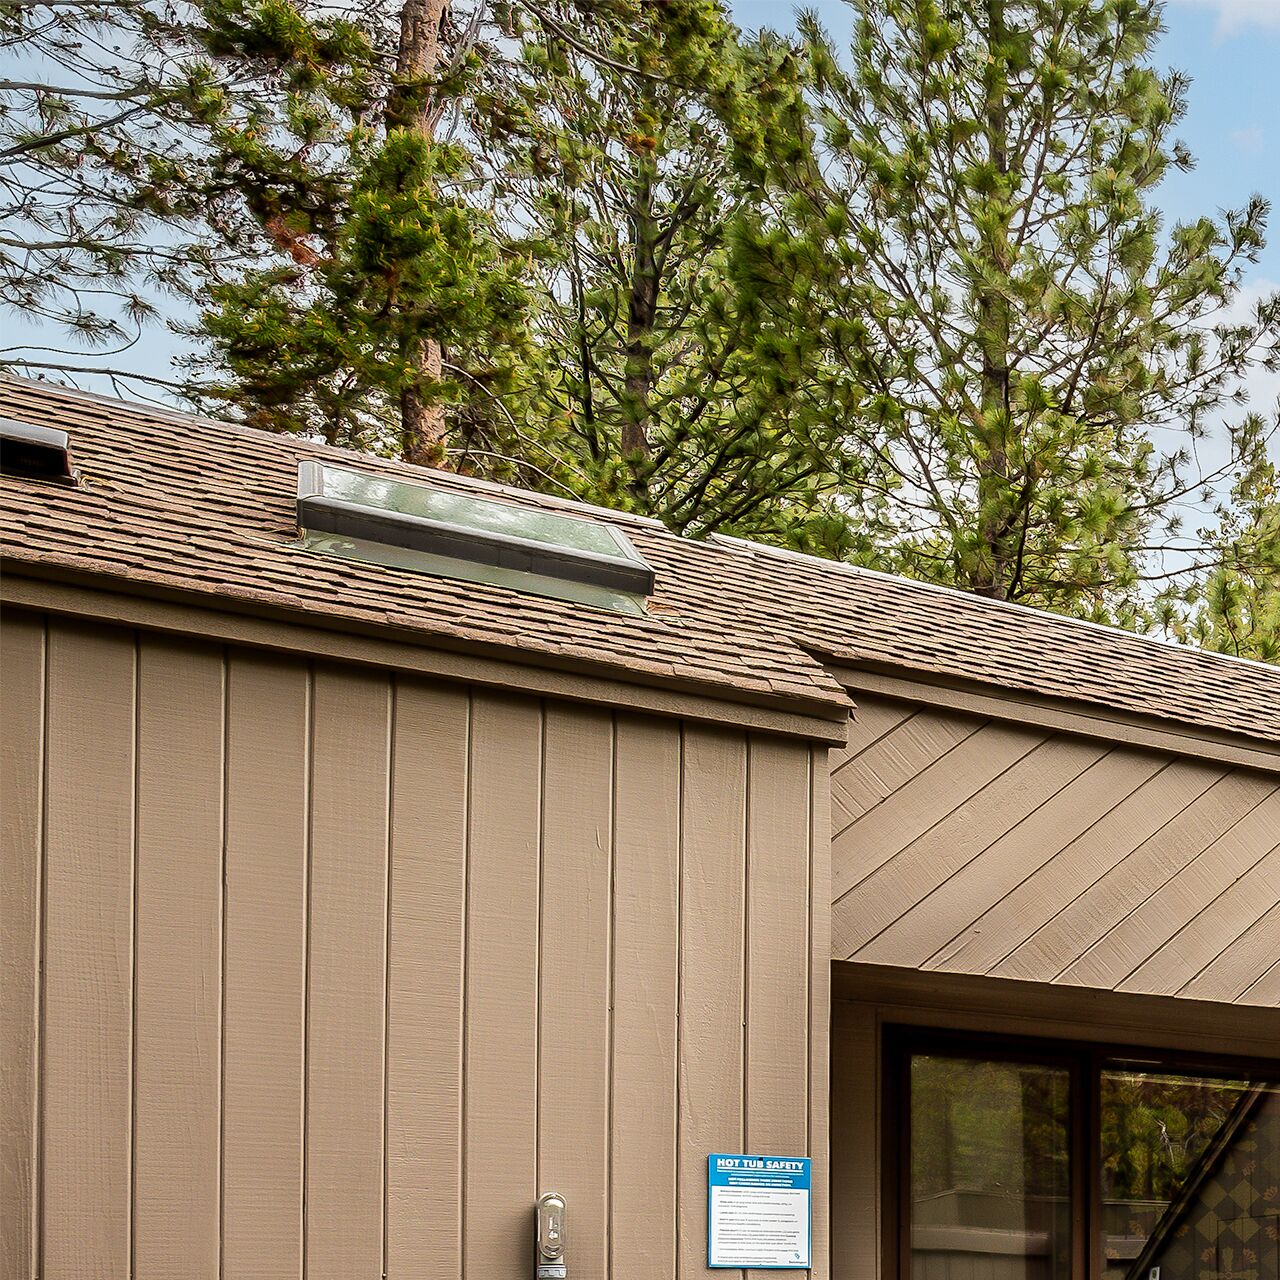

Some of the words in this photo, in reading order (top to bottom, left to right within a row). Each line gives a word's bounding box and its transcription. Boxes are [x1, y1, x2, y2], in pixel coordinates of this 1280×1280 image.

[717, 1158, 740, 1167] HOT
[742, 1159, 764, 1169] TUB
[766, 1161, 804, 1170] SAFETY
